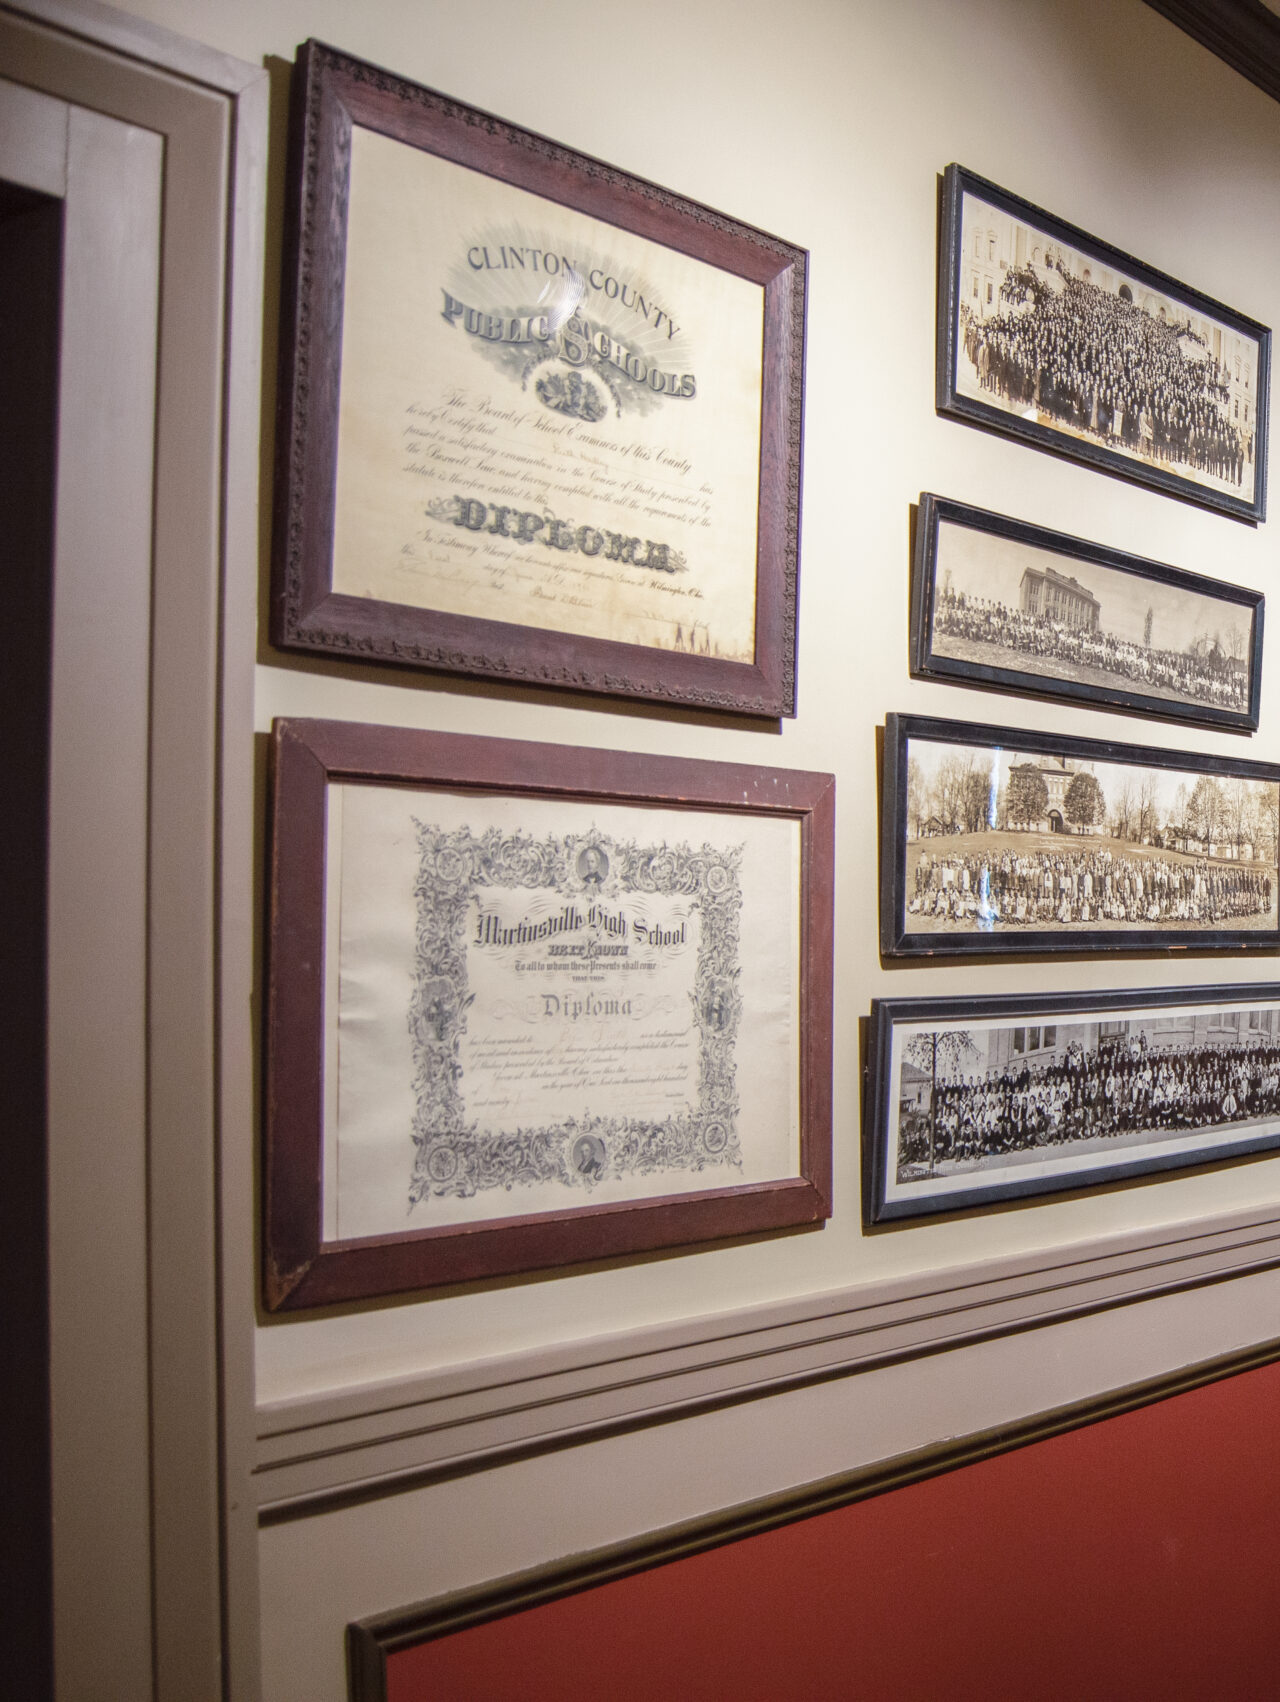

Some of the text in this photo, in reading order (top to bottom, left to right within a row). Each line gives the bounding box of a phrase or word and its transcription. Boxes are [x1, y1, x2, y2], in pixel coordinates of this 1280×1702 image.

[467, 246, 680, 340] CLINTON COUNTY
[440, 287, 697, 399] PUBLIC SCHOOLS
[654, 446, 694, 476] County
[453, 494, 677, 573] DIPLOMA
[474, 904, 686, 946] Martinsville High School
[540, 991, 633, 1020] Diploma
